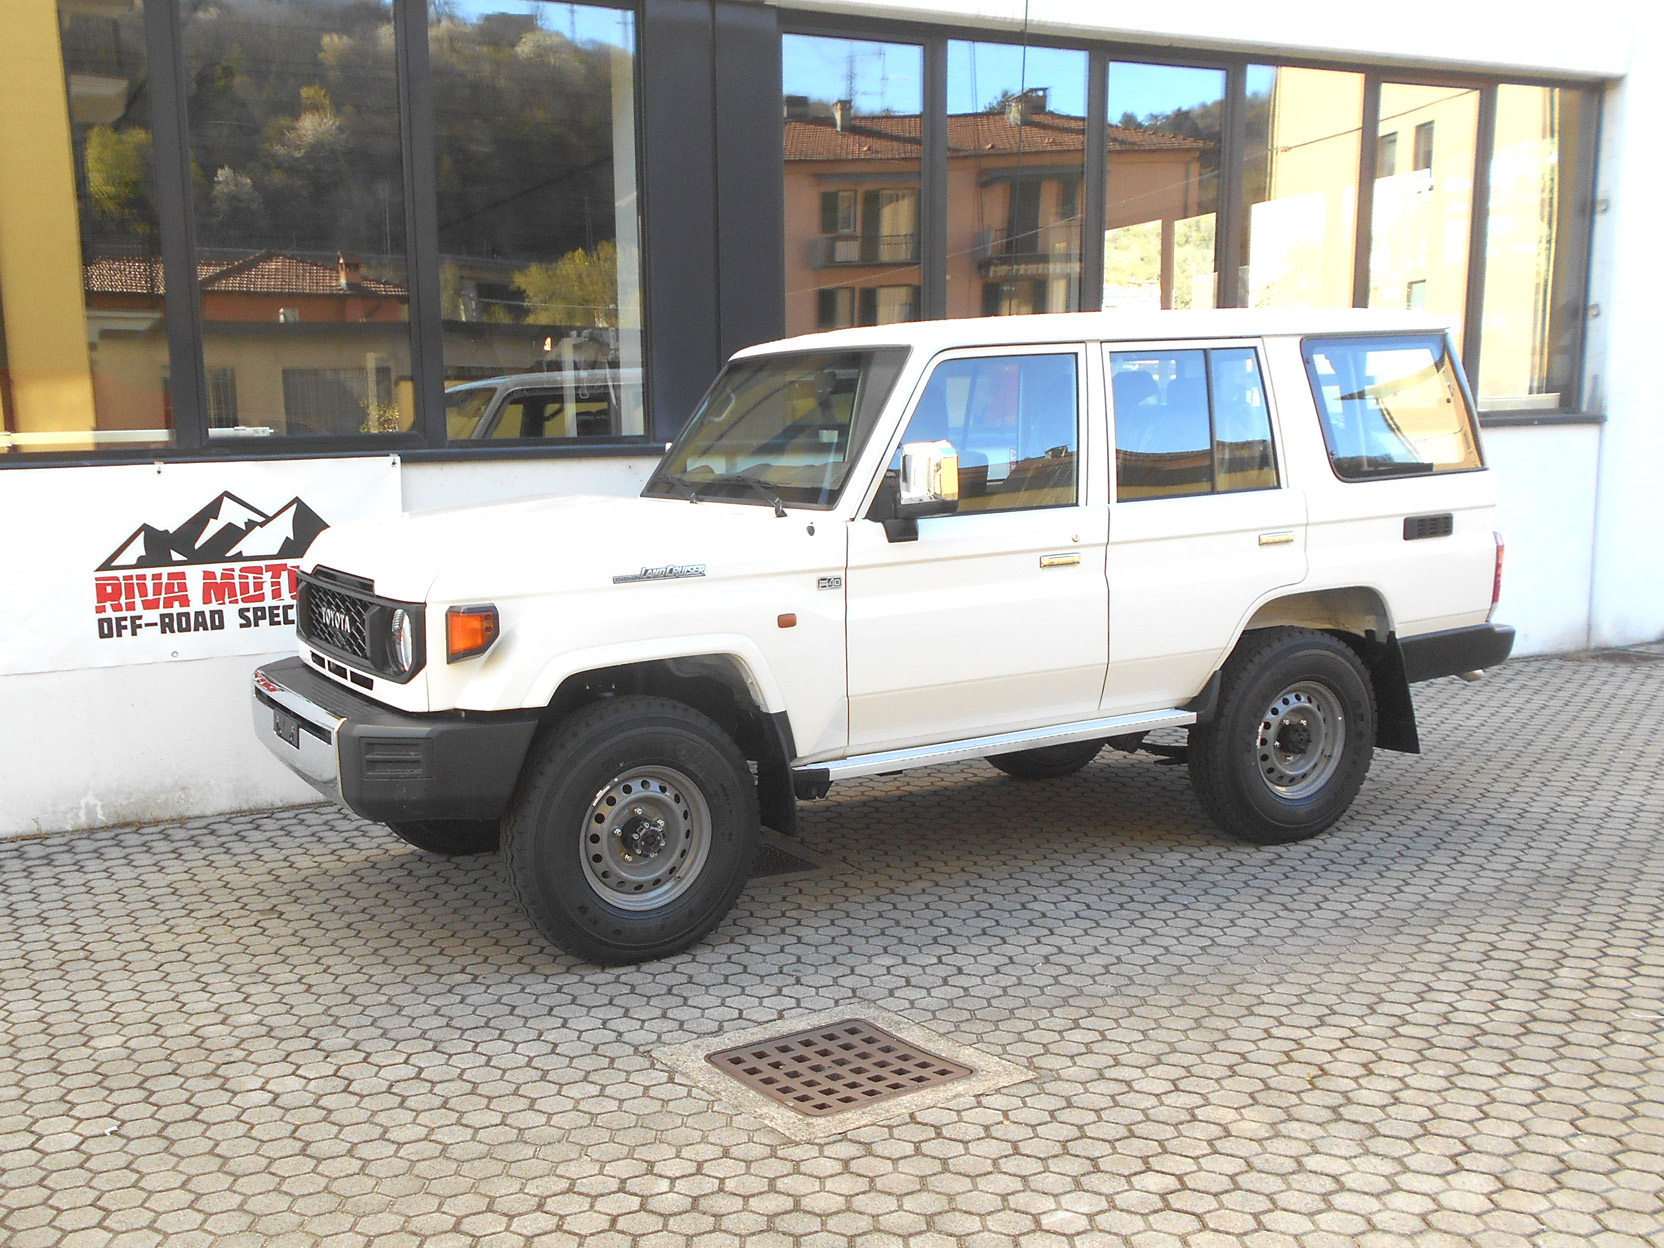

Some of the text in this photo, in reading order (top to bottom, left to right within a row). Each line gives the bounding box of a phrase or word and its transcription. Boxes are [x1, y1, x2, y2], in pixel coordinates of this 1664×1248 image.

[95, 571, 191, 614] RIVA
[98, 609, 225, 639] OFF-ROAD
[321, 607, 351, 633] TOYOTA
